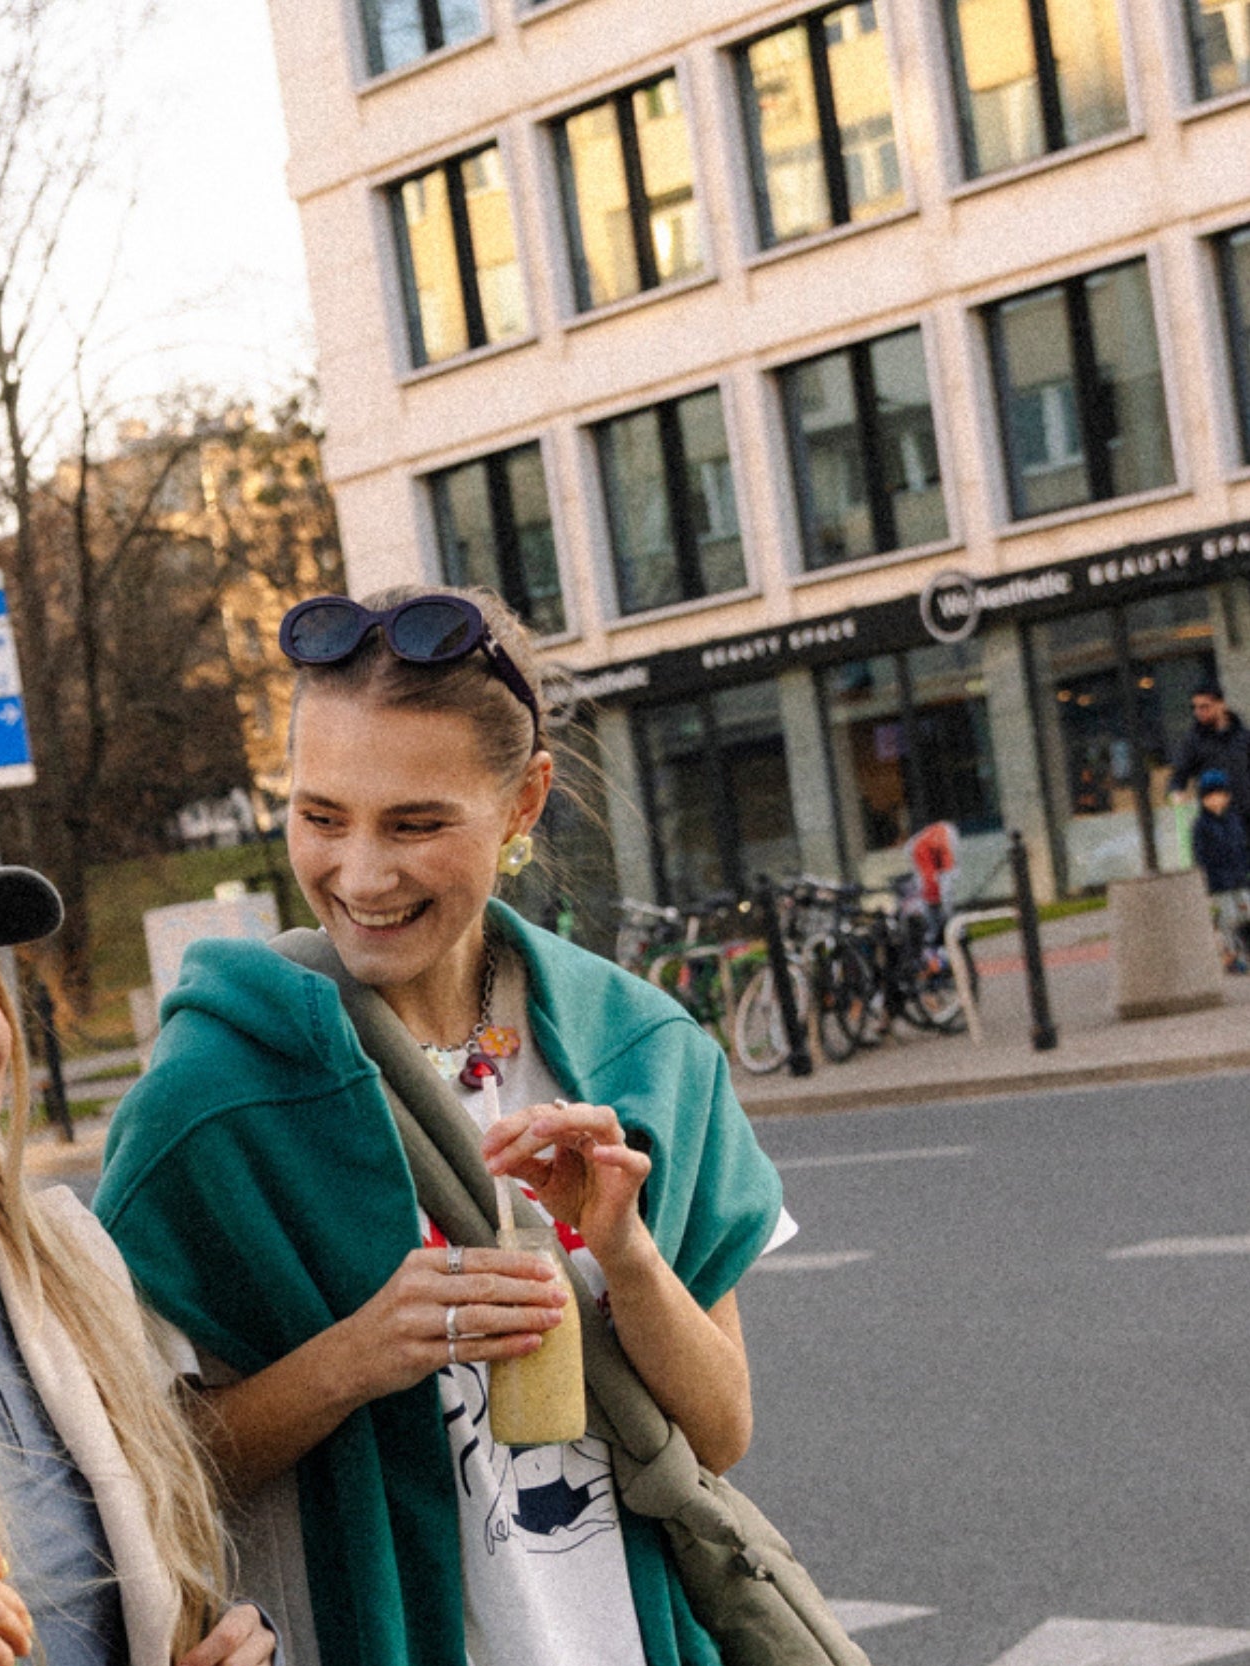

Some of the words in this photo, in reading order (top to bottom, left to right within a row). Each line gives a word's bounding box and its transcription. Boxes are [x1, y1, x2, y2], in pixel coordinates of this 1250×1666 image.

[1088, 545, 1190, 586] BEAUTY
[701, 634, 781, 669] BEAUTY
[788, 617, 856, 651] SPACE
